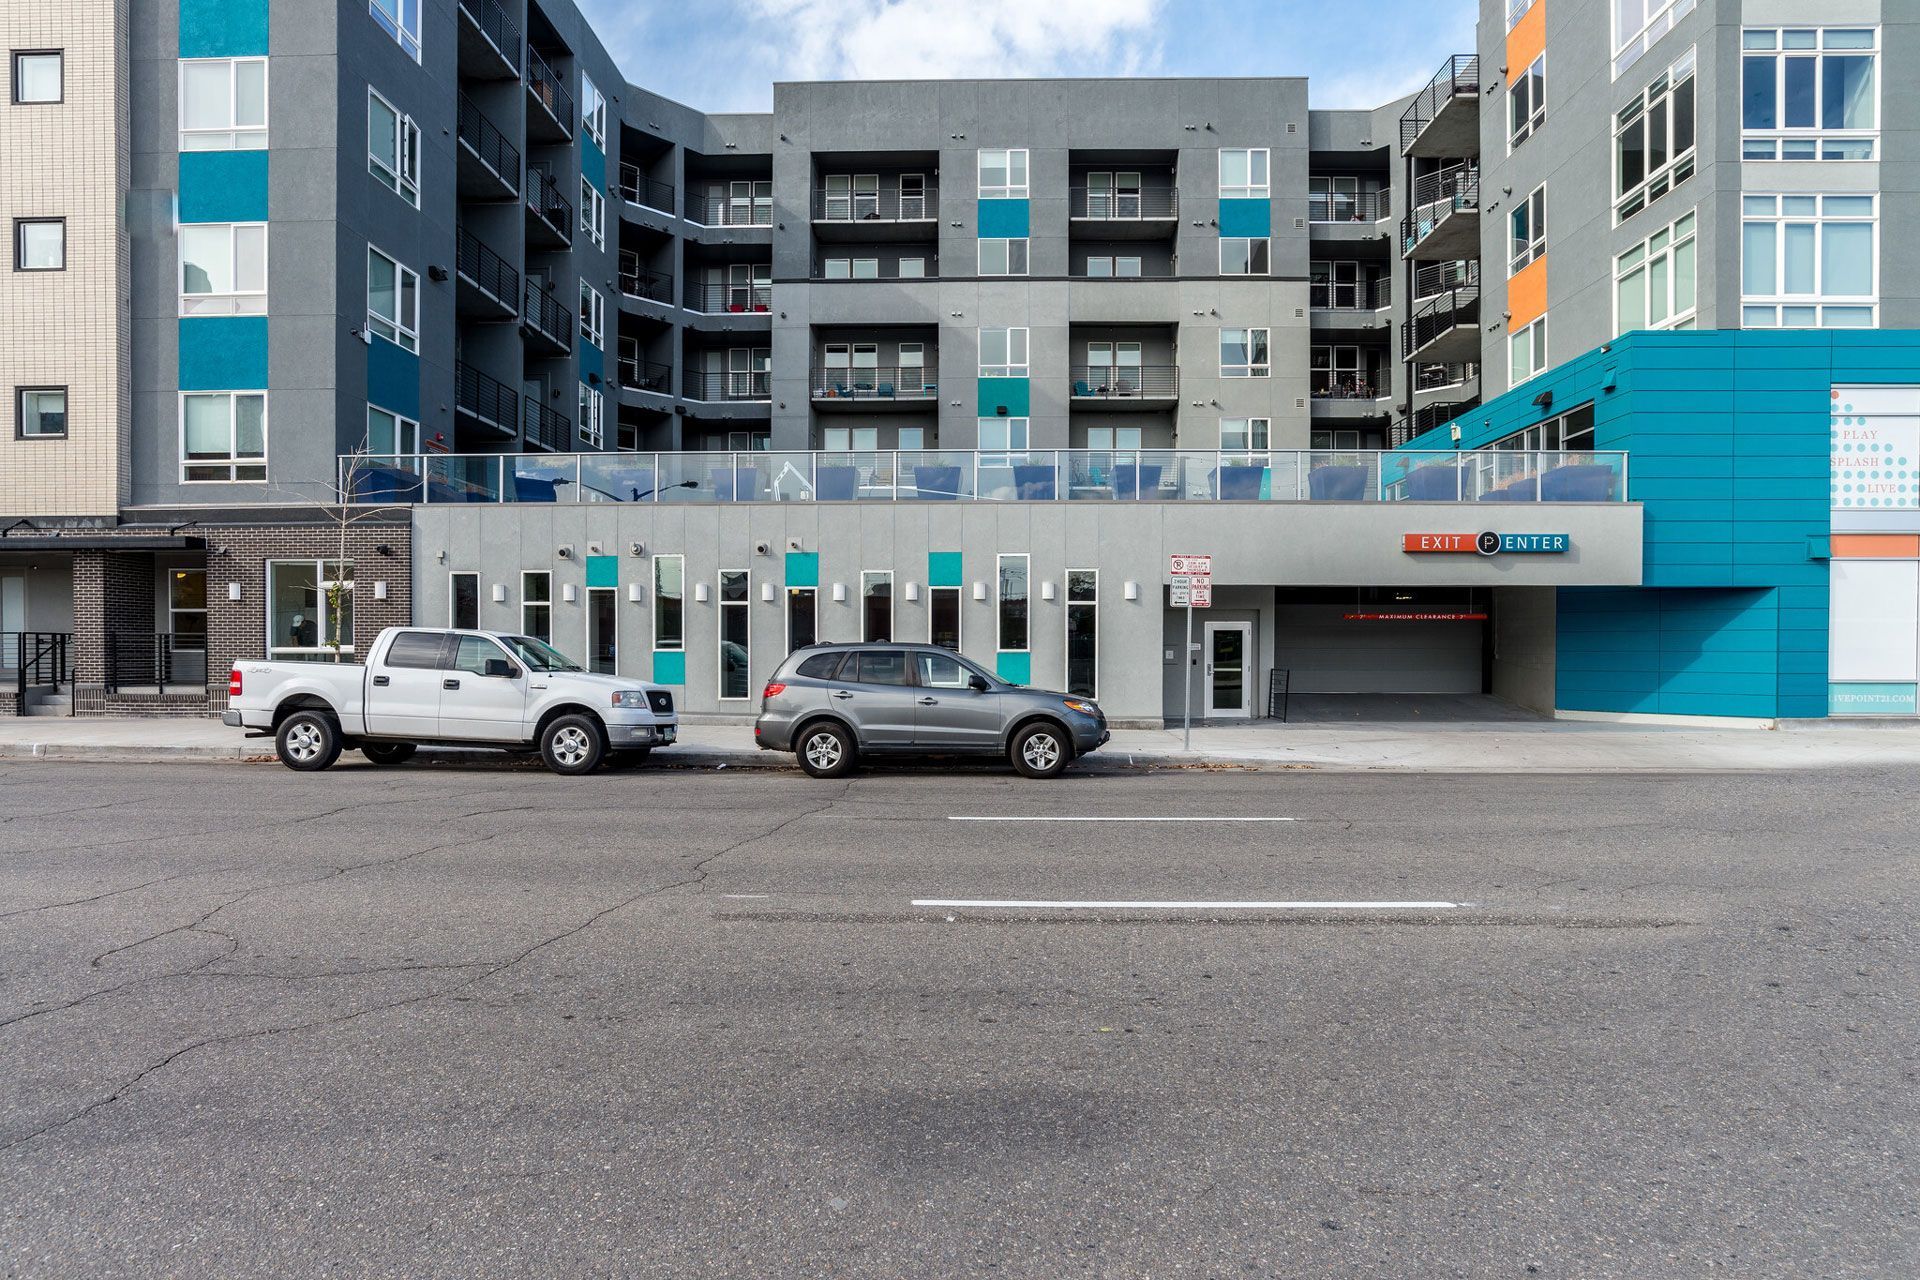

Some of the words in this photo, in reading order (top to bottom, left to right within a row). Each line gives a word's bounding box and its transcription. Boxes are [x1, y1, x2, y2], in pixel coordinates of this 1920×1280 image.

[1843, 430, 1878, 439] PLAY
[1830, 457, 1878, 467] SPLASH
[1867, 484, 1897, 493] LIVE
[1421, 536, 1461, 549] EXIT
[1484, 536, 1494, 549] P
[1506, 536, 1563, 549] ENTER
